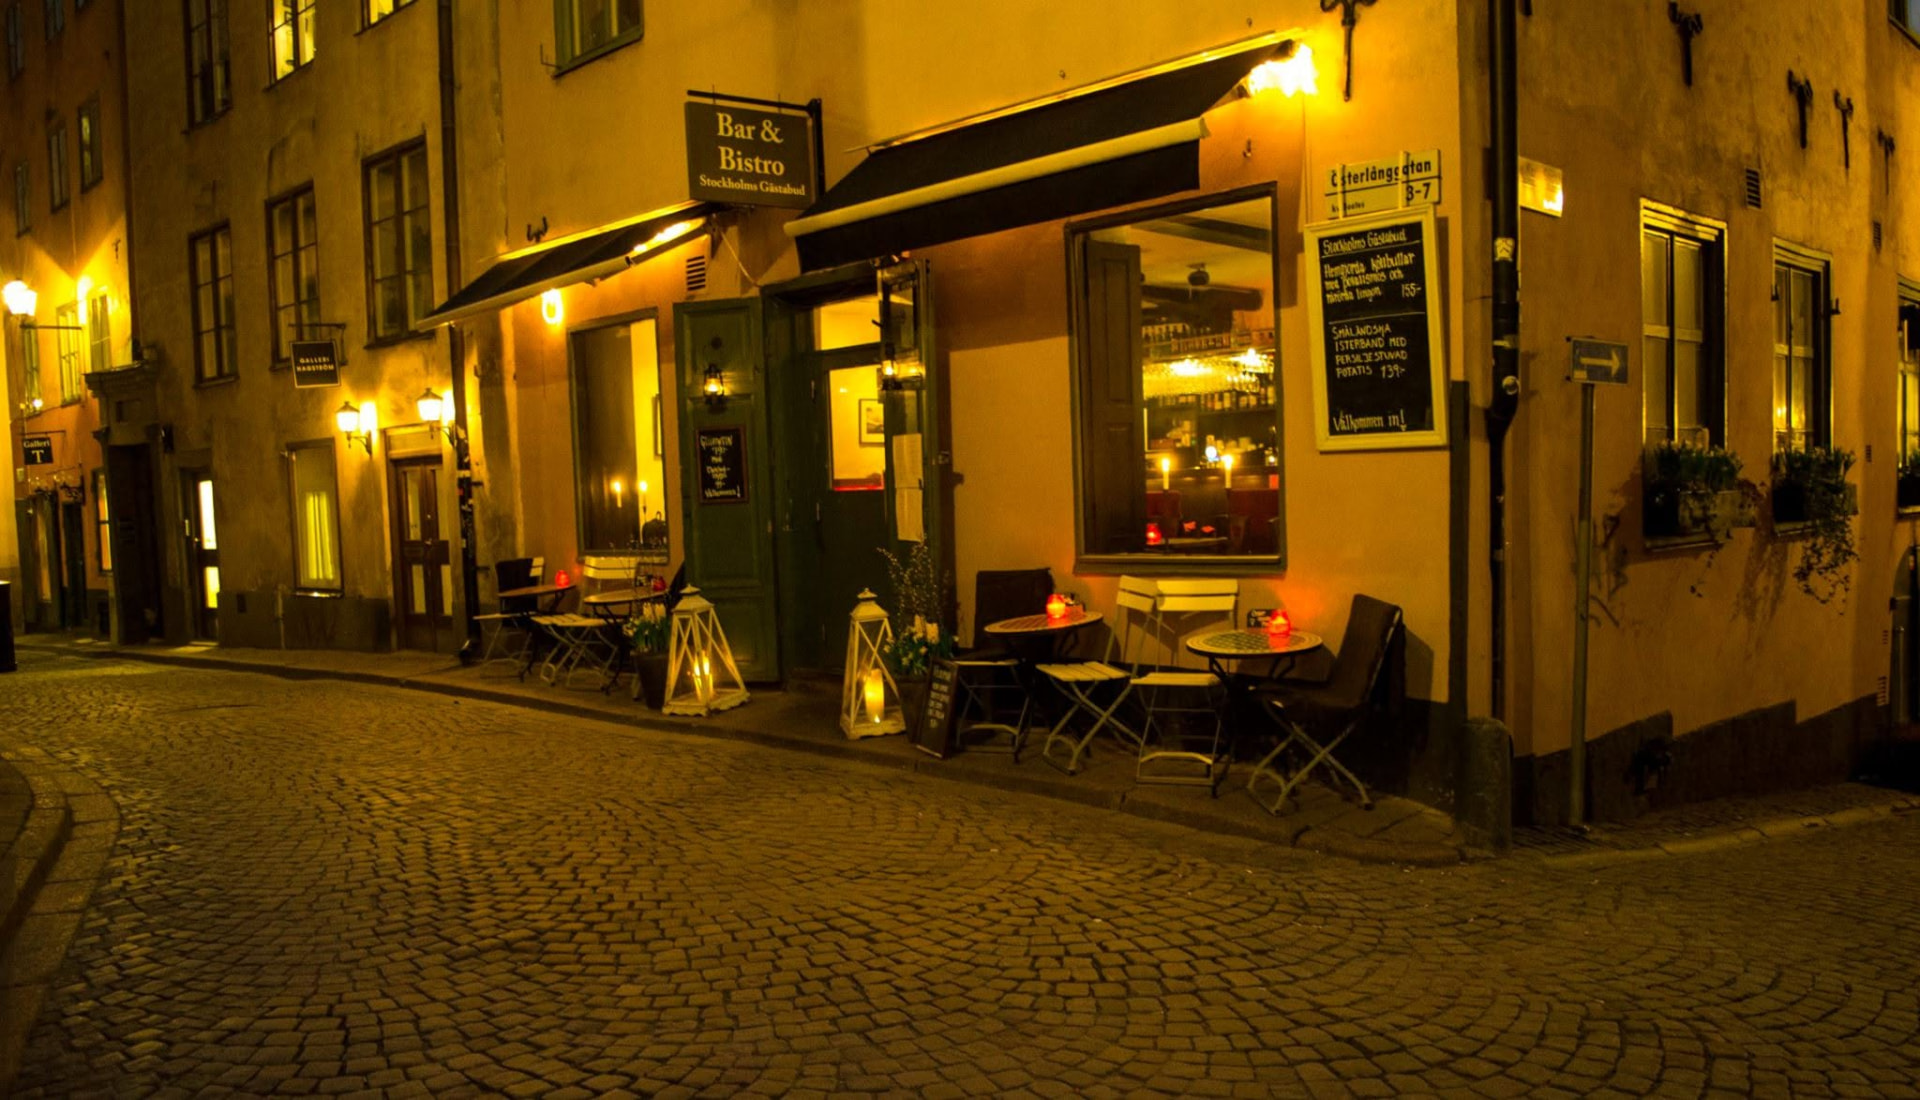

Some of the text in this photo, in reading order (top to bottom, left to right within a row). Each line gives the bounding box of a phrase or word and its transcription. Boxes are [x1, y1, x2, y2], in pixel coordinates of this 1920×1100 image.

[717, 112, 784, 144] Bar &
[718, 146, 785, 176] Bistro
[699, 174, 806, 196] Stockholms Gästabud
[1406, 182, 1431, 202] 3-7
[1323, 229, 1407, 255] Stockholms Gästabud
[1389, 267, 1404, 280] och
[1335, 337, 1407, 352] ISTERBAND MED
[1336, 365, 1372, 379] POTATIS
[23, 440, 50, 448] Galleri
[32, 450, 44, 463] T
